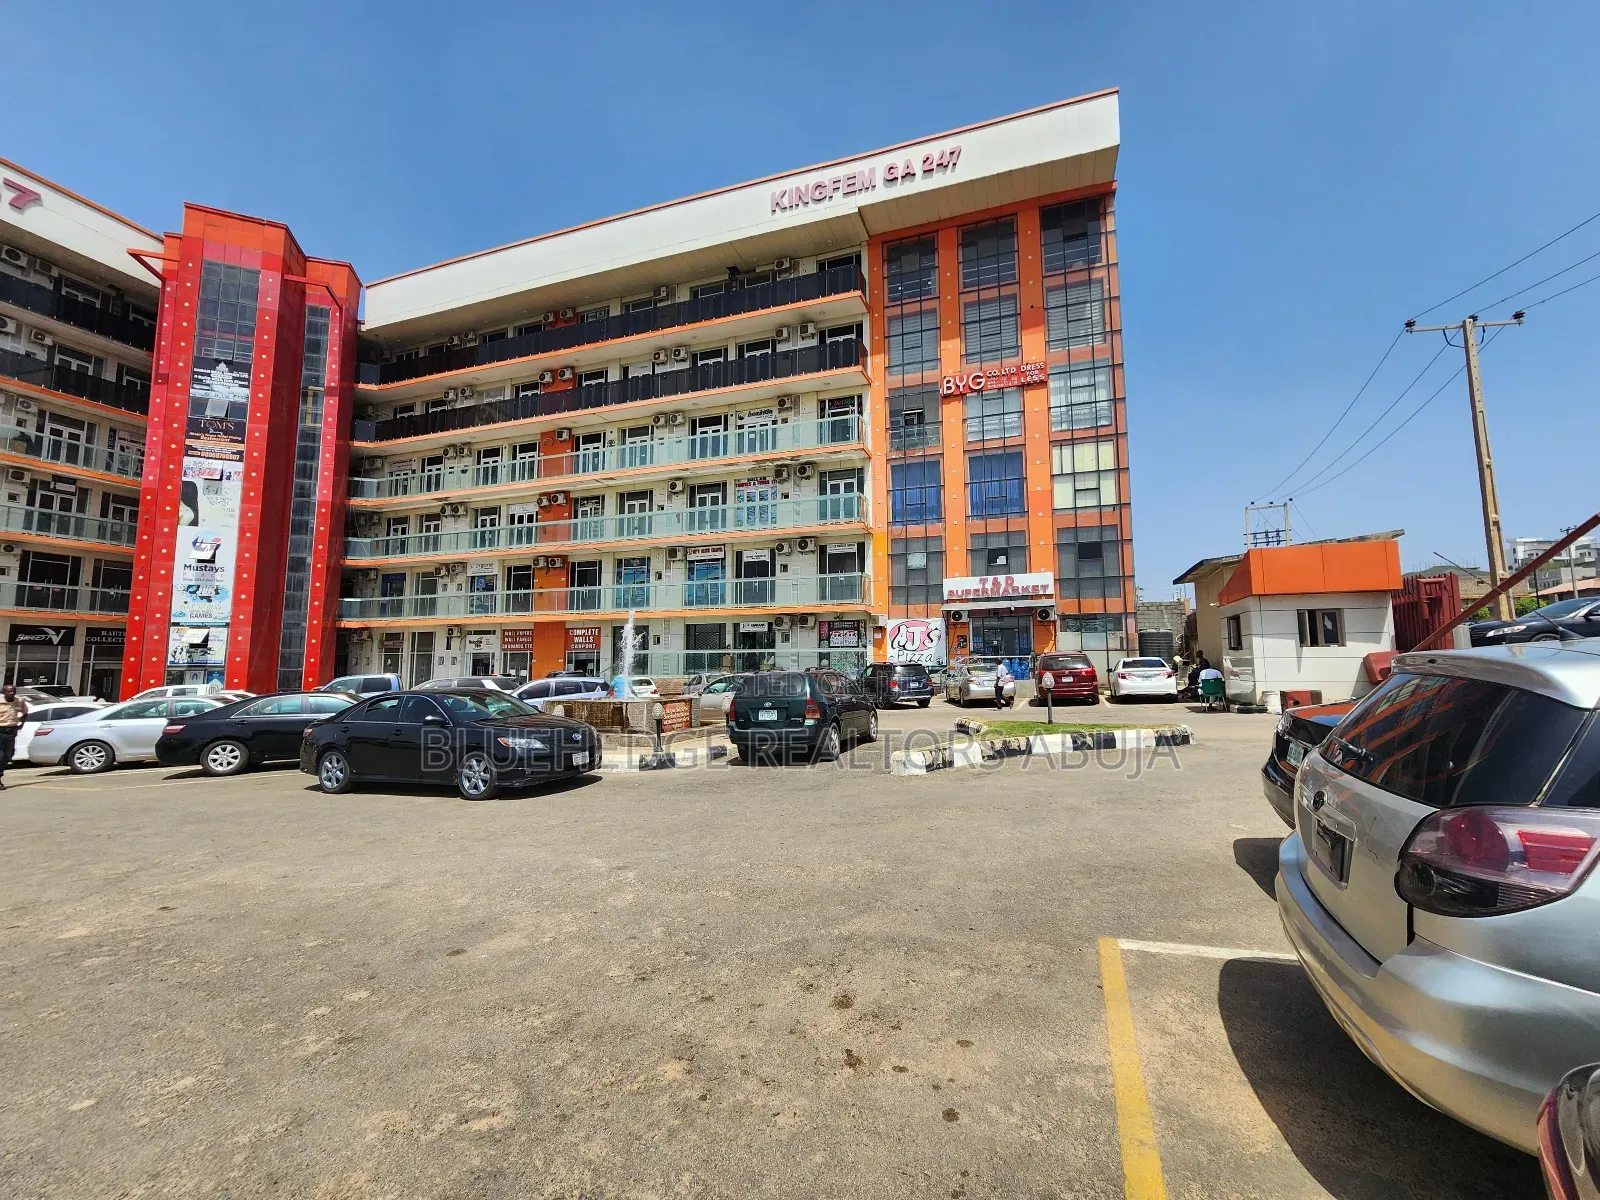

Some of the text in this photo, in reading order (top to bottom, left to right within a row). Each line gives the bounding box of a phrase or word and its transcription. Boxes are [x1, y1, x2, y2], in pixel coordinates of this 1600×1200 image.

[770, 145, 962, 213] KINGFEM GA 247
[1001, 366, 1017, 376] LTD
[1020, 361, 1045, 372] DRESS
[943, 372, 986, 395] BYG
[1021, 375, 1046, 383] LESS
[183, 563, 225, 573] Mustays
[978, 575, 1015, 587] T & D
[947, 583, 1049, 599] SUPERMARKET
[569, 628, 599, 636] COMPLETE
[897, 650, 934, 663] Pizza
